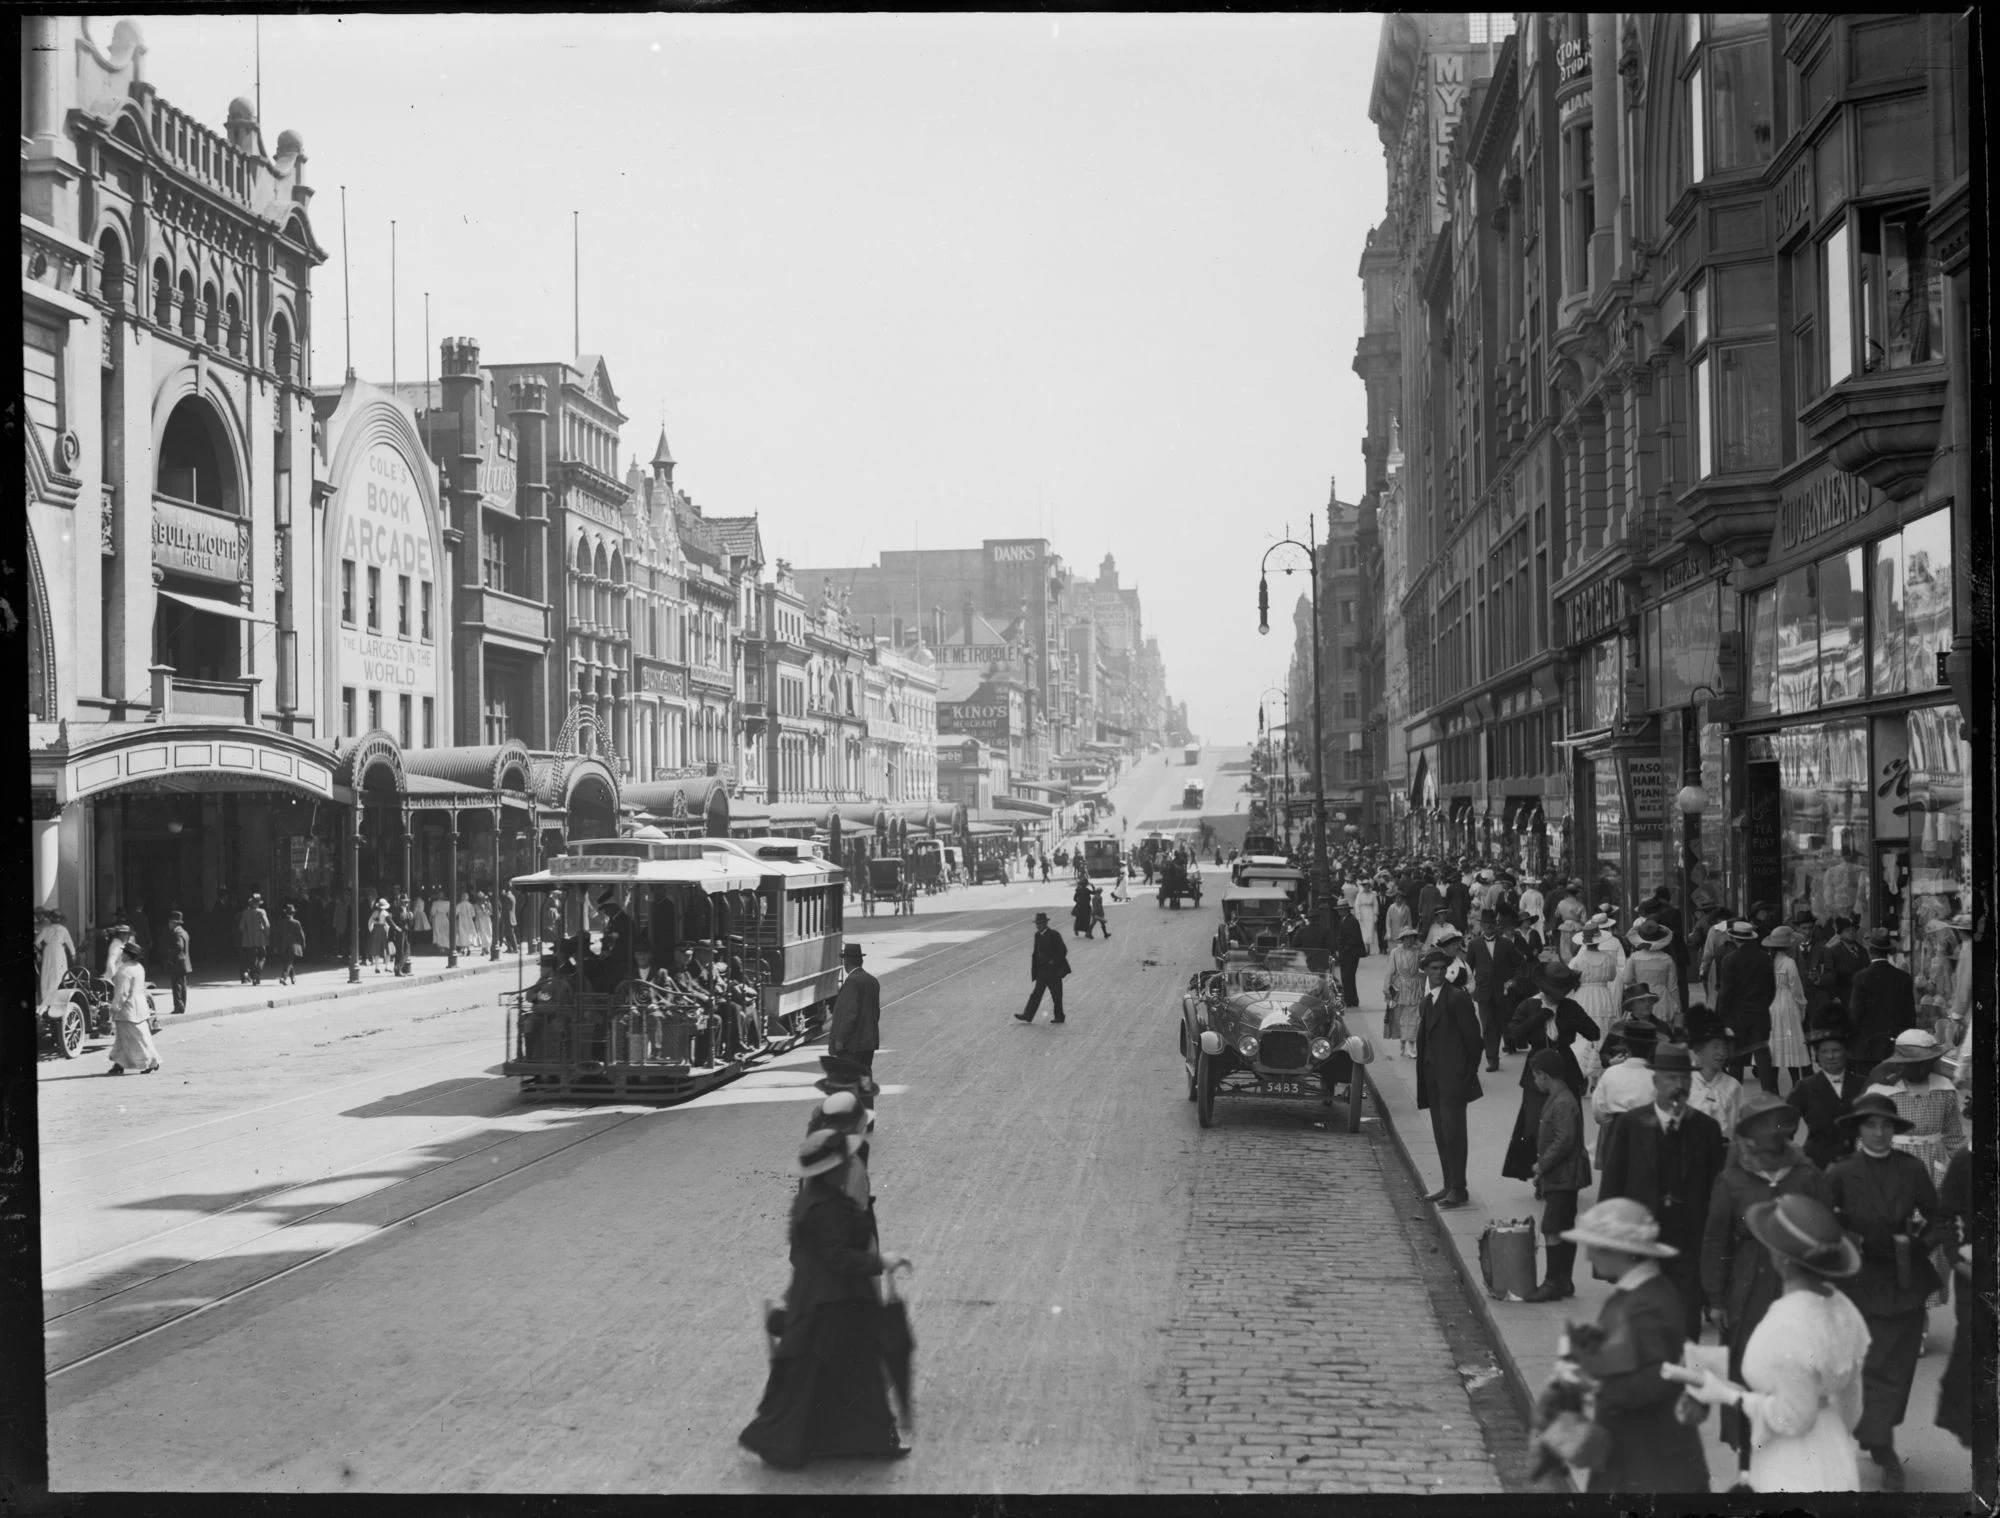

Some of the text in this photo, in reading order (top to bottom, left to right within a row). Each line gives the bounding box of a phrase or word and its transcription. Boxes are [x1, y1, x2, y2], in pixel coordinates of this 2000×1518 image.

[369, 454, 407, 485] COLE'S
[367, 481, 411, 524] BOOK
[157, 522, 187, 550] BULL
[196, 531, 237, 561] MOUTH
[344, 513, 430, 577] ARCADE
[183, 550, 215, 572] HOTEL
[343, 636, 432, 668] THE LARGEST IN THE
[952, 646, 1015, 665] METROPOLE
[952, 719, 998, 729] MERCHANT
[1267, 1082, 1299, 1094] 5483
